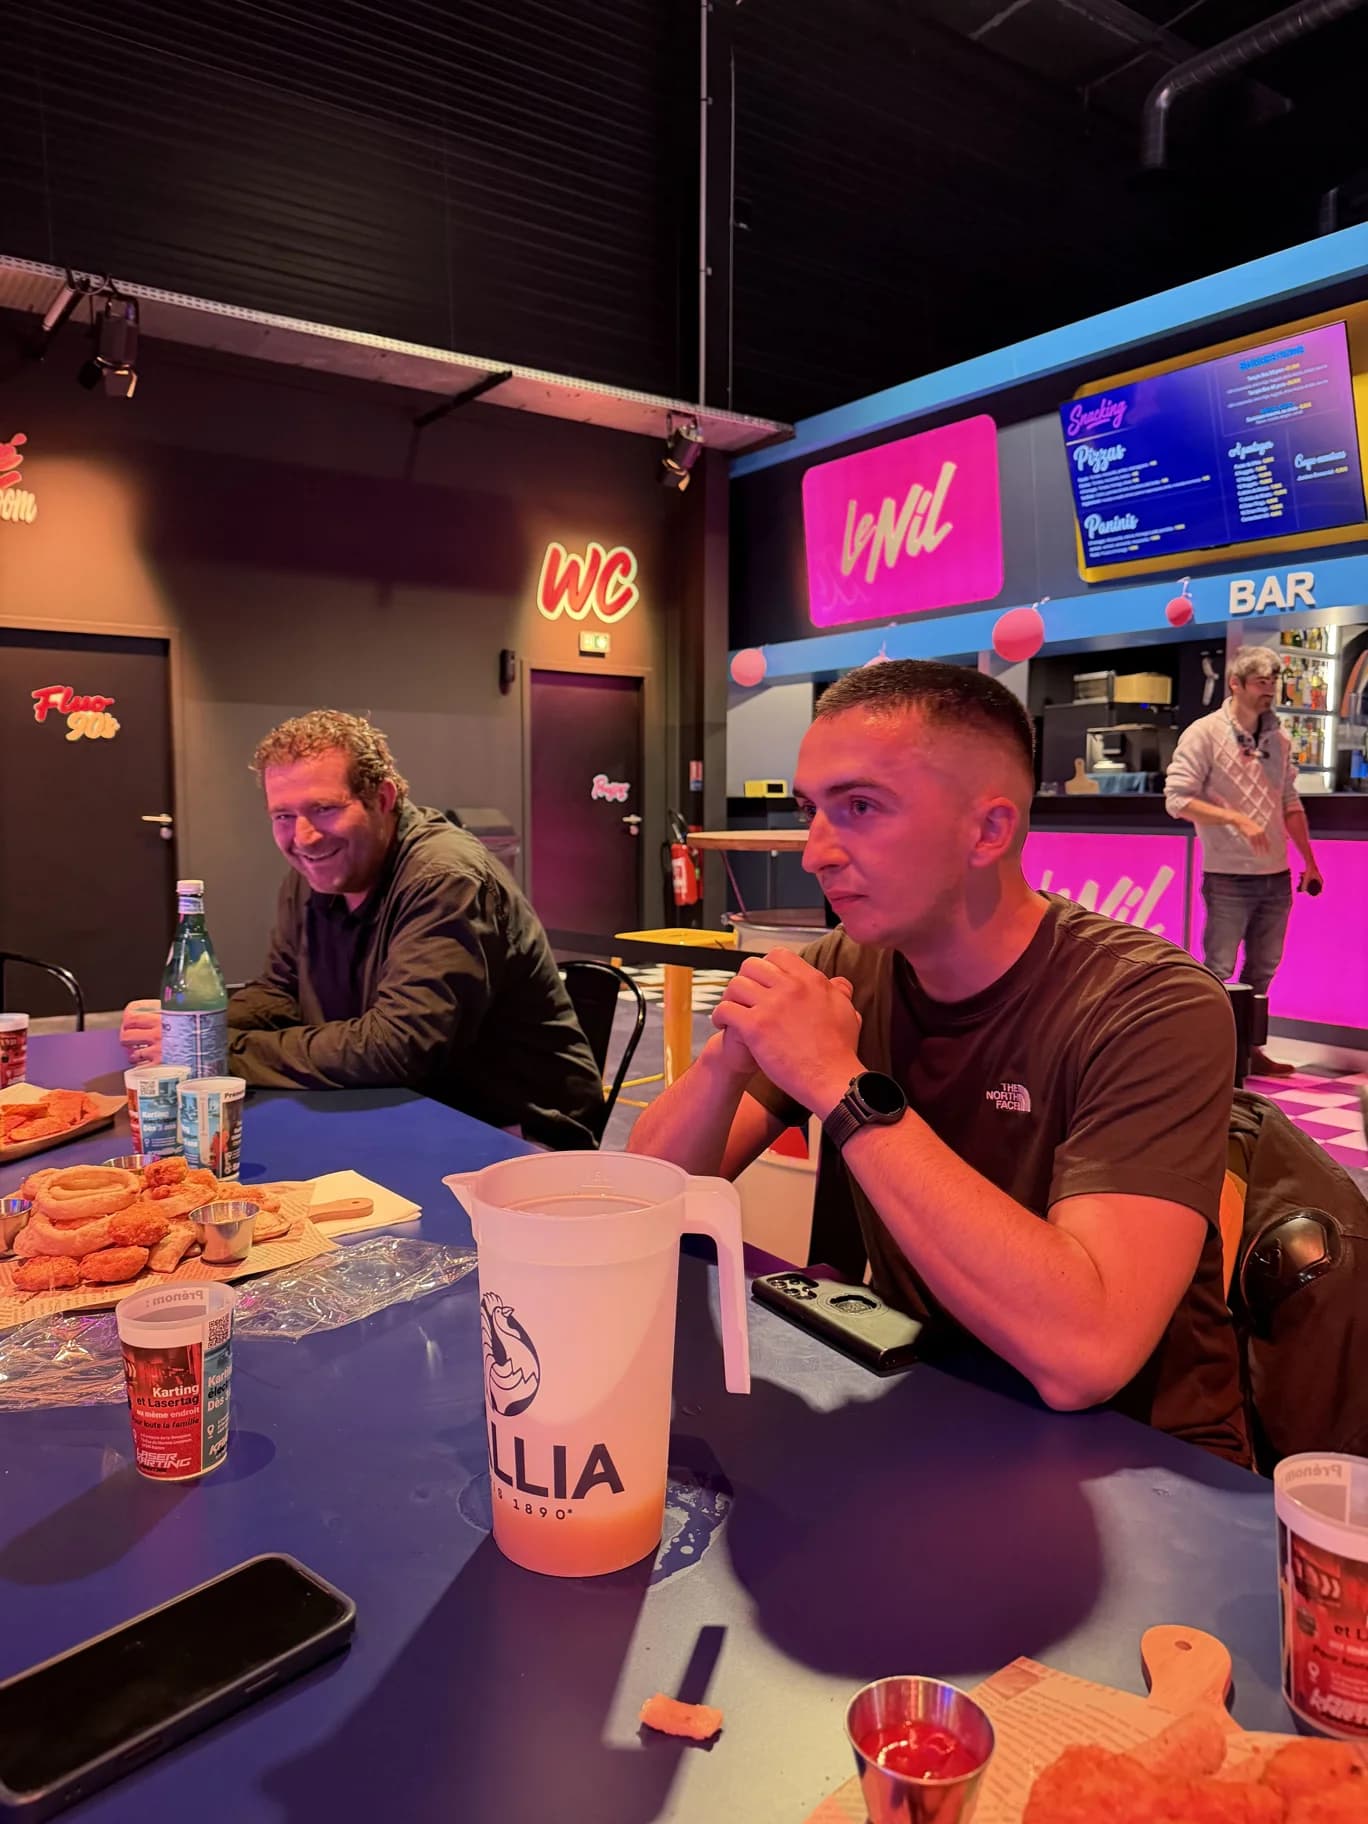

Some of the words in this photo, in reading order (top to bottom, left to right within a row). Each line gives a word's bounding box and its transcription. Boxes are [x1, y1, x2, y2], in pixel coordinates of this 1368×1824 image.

[1073, 443, 1127, 474] Pizzas
[1083, 512, 1139, 540] Paninis
[537, 542, 640, 623] WC
[1229, 570, 1316, 615] BAR
[31, 685, 115, 722] Fluo
[986, 1090, 1020, 1102] NORTH
[1000, 1083, 1019, 1093] THE
[995, 1100, 1020, 1111] FACE
[152, 1384, 200, 1399] Karting
[136, 1397, 146, 1407] et
[147, 1393, 200, 1409] Lasertag
[169, 1406, 200, 1419] endroit
[171, 1416, 201, 1430] famille
[488, 1420, 625, 1500] LLIA
